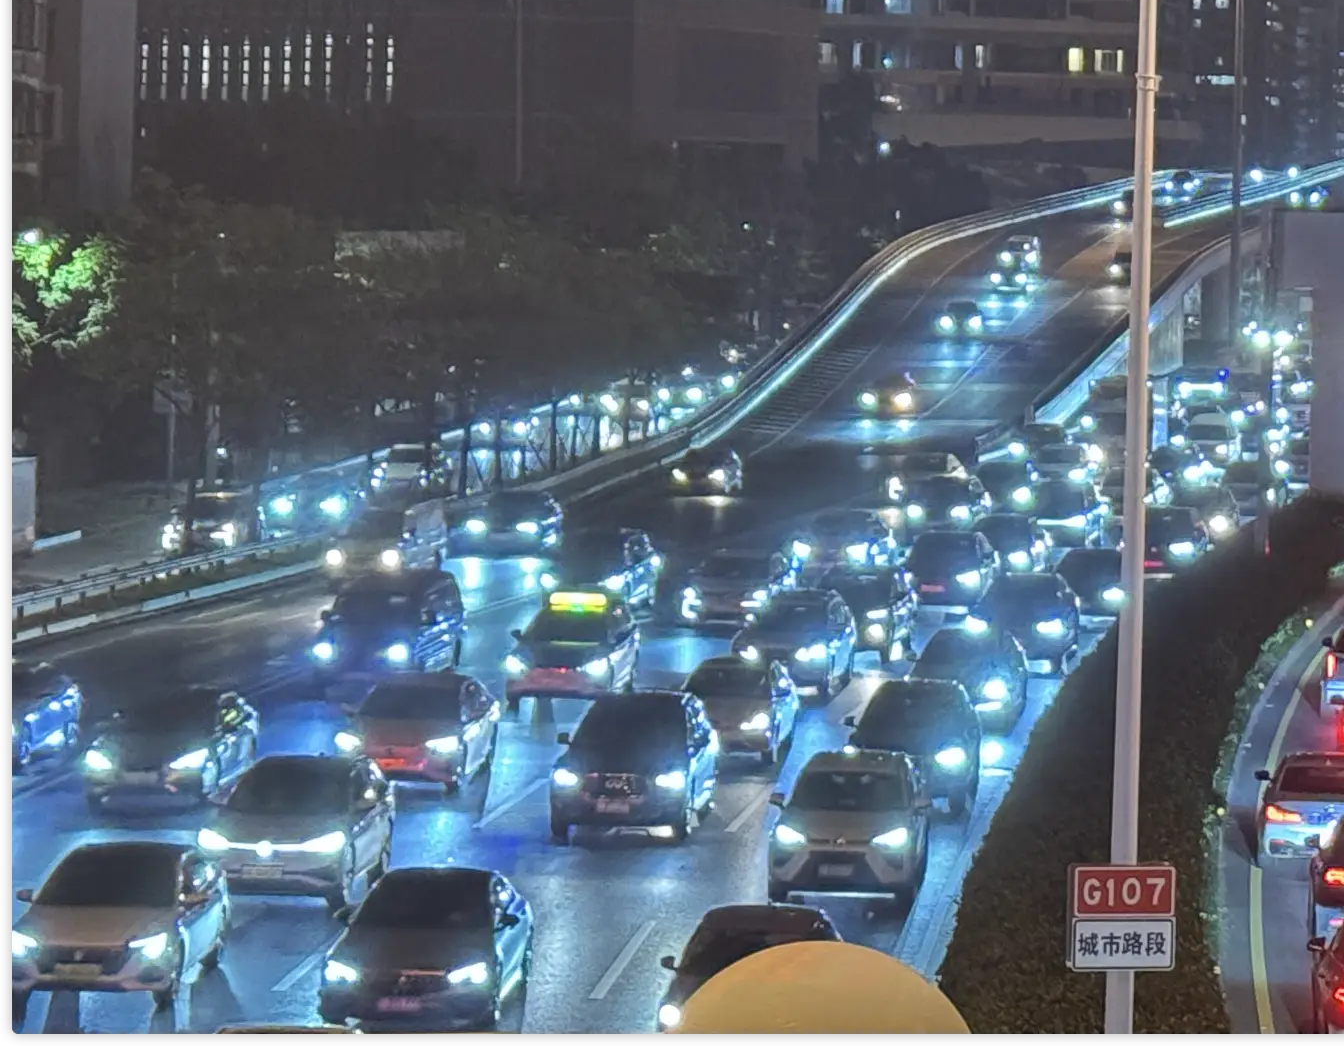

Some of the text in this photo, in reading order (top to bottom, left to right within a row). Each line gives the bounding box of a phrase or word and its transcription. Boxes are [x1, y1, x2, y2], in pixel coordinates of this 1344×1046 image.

[1083, 877, 1166, 907] G107
[1077, 931, 1167, 957] 城市路段
